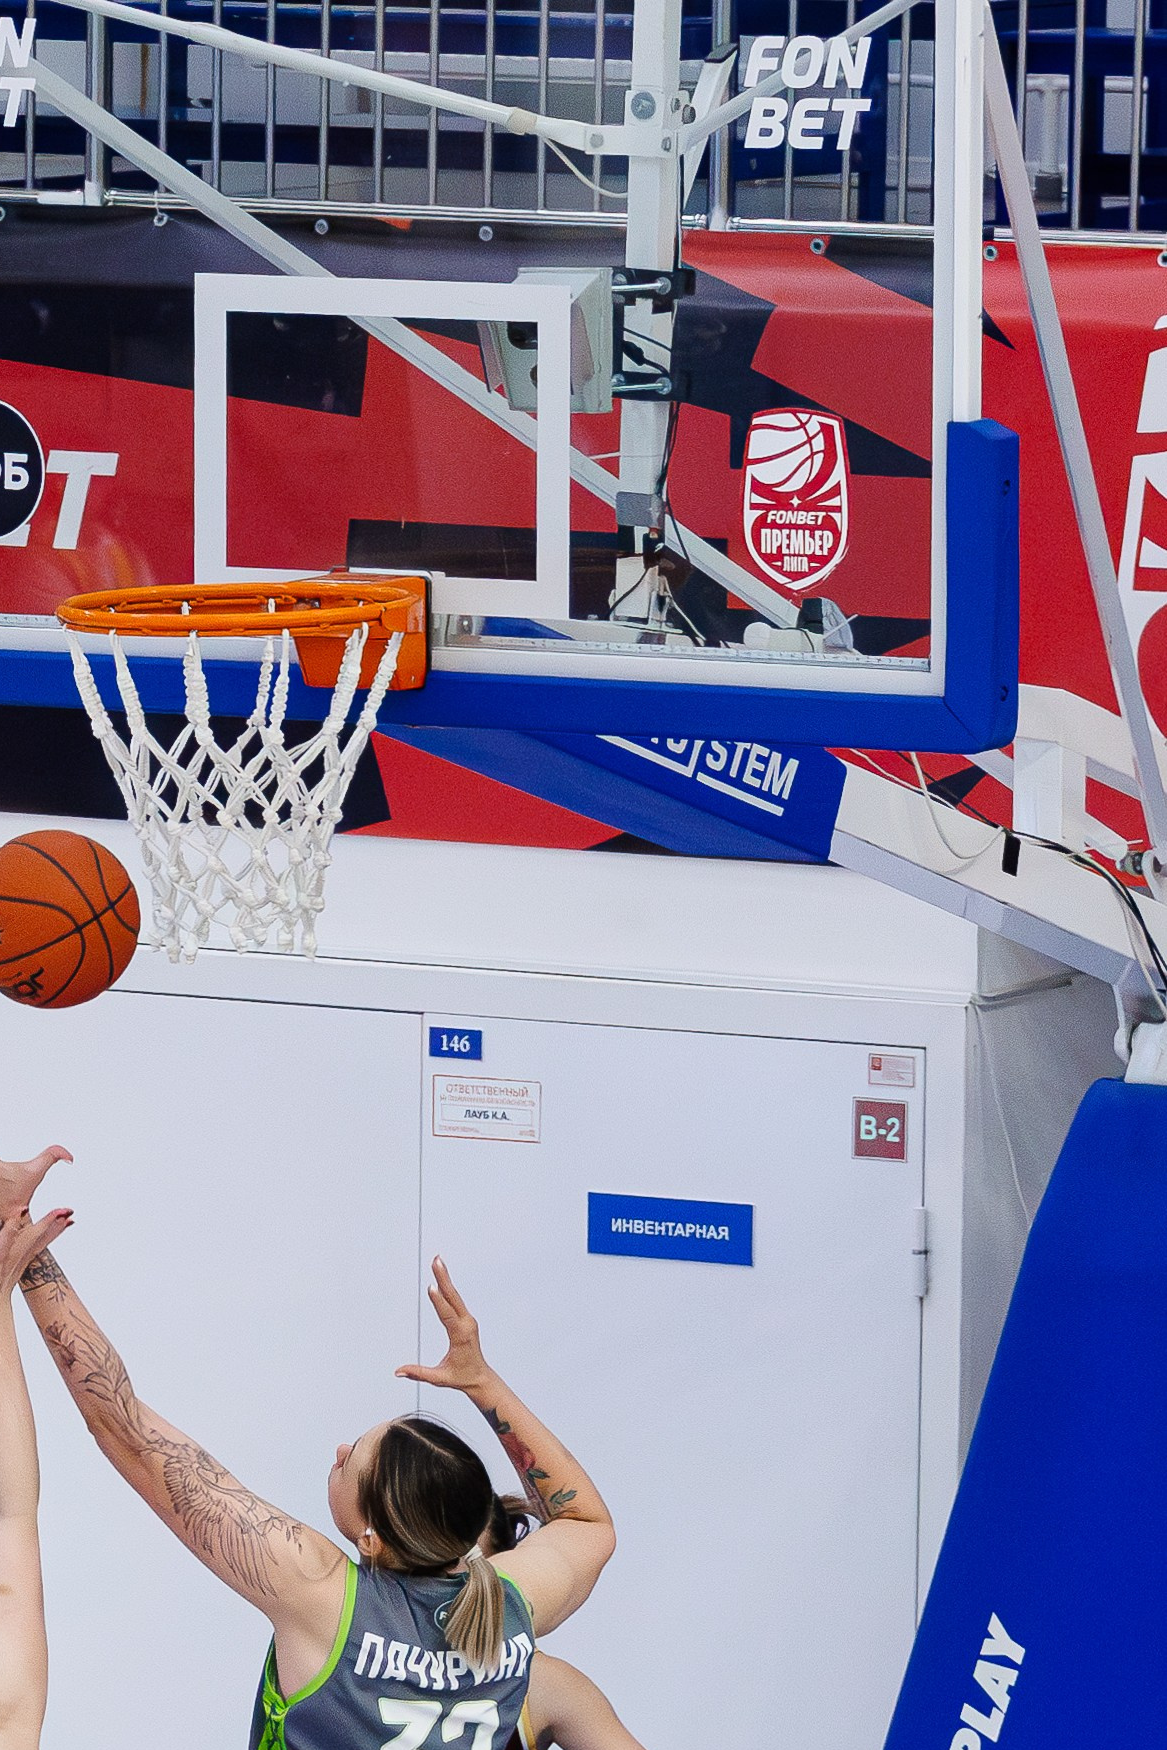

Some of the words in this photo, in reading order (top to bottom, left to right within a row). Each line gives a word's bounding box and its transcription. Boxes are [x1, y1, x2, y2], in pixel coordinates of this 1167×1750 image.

[744, 35, 872, 89] FON
[744, 97, 872, 150] BET
[766, 510, 827, 526] FONBET
[760, 528, 834, 556] ПРЕМЬЕР
[782, 555, 809, 572] ЛИГА
[440, 1034, 471, 1053] 146
[445, 1084, 529, 1098] ОТВЕТСТВЕННЫЙ
[611, 1218, 730, 1241] ИНВЕНТАРНАЯ
